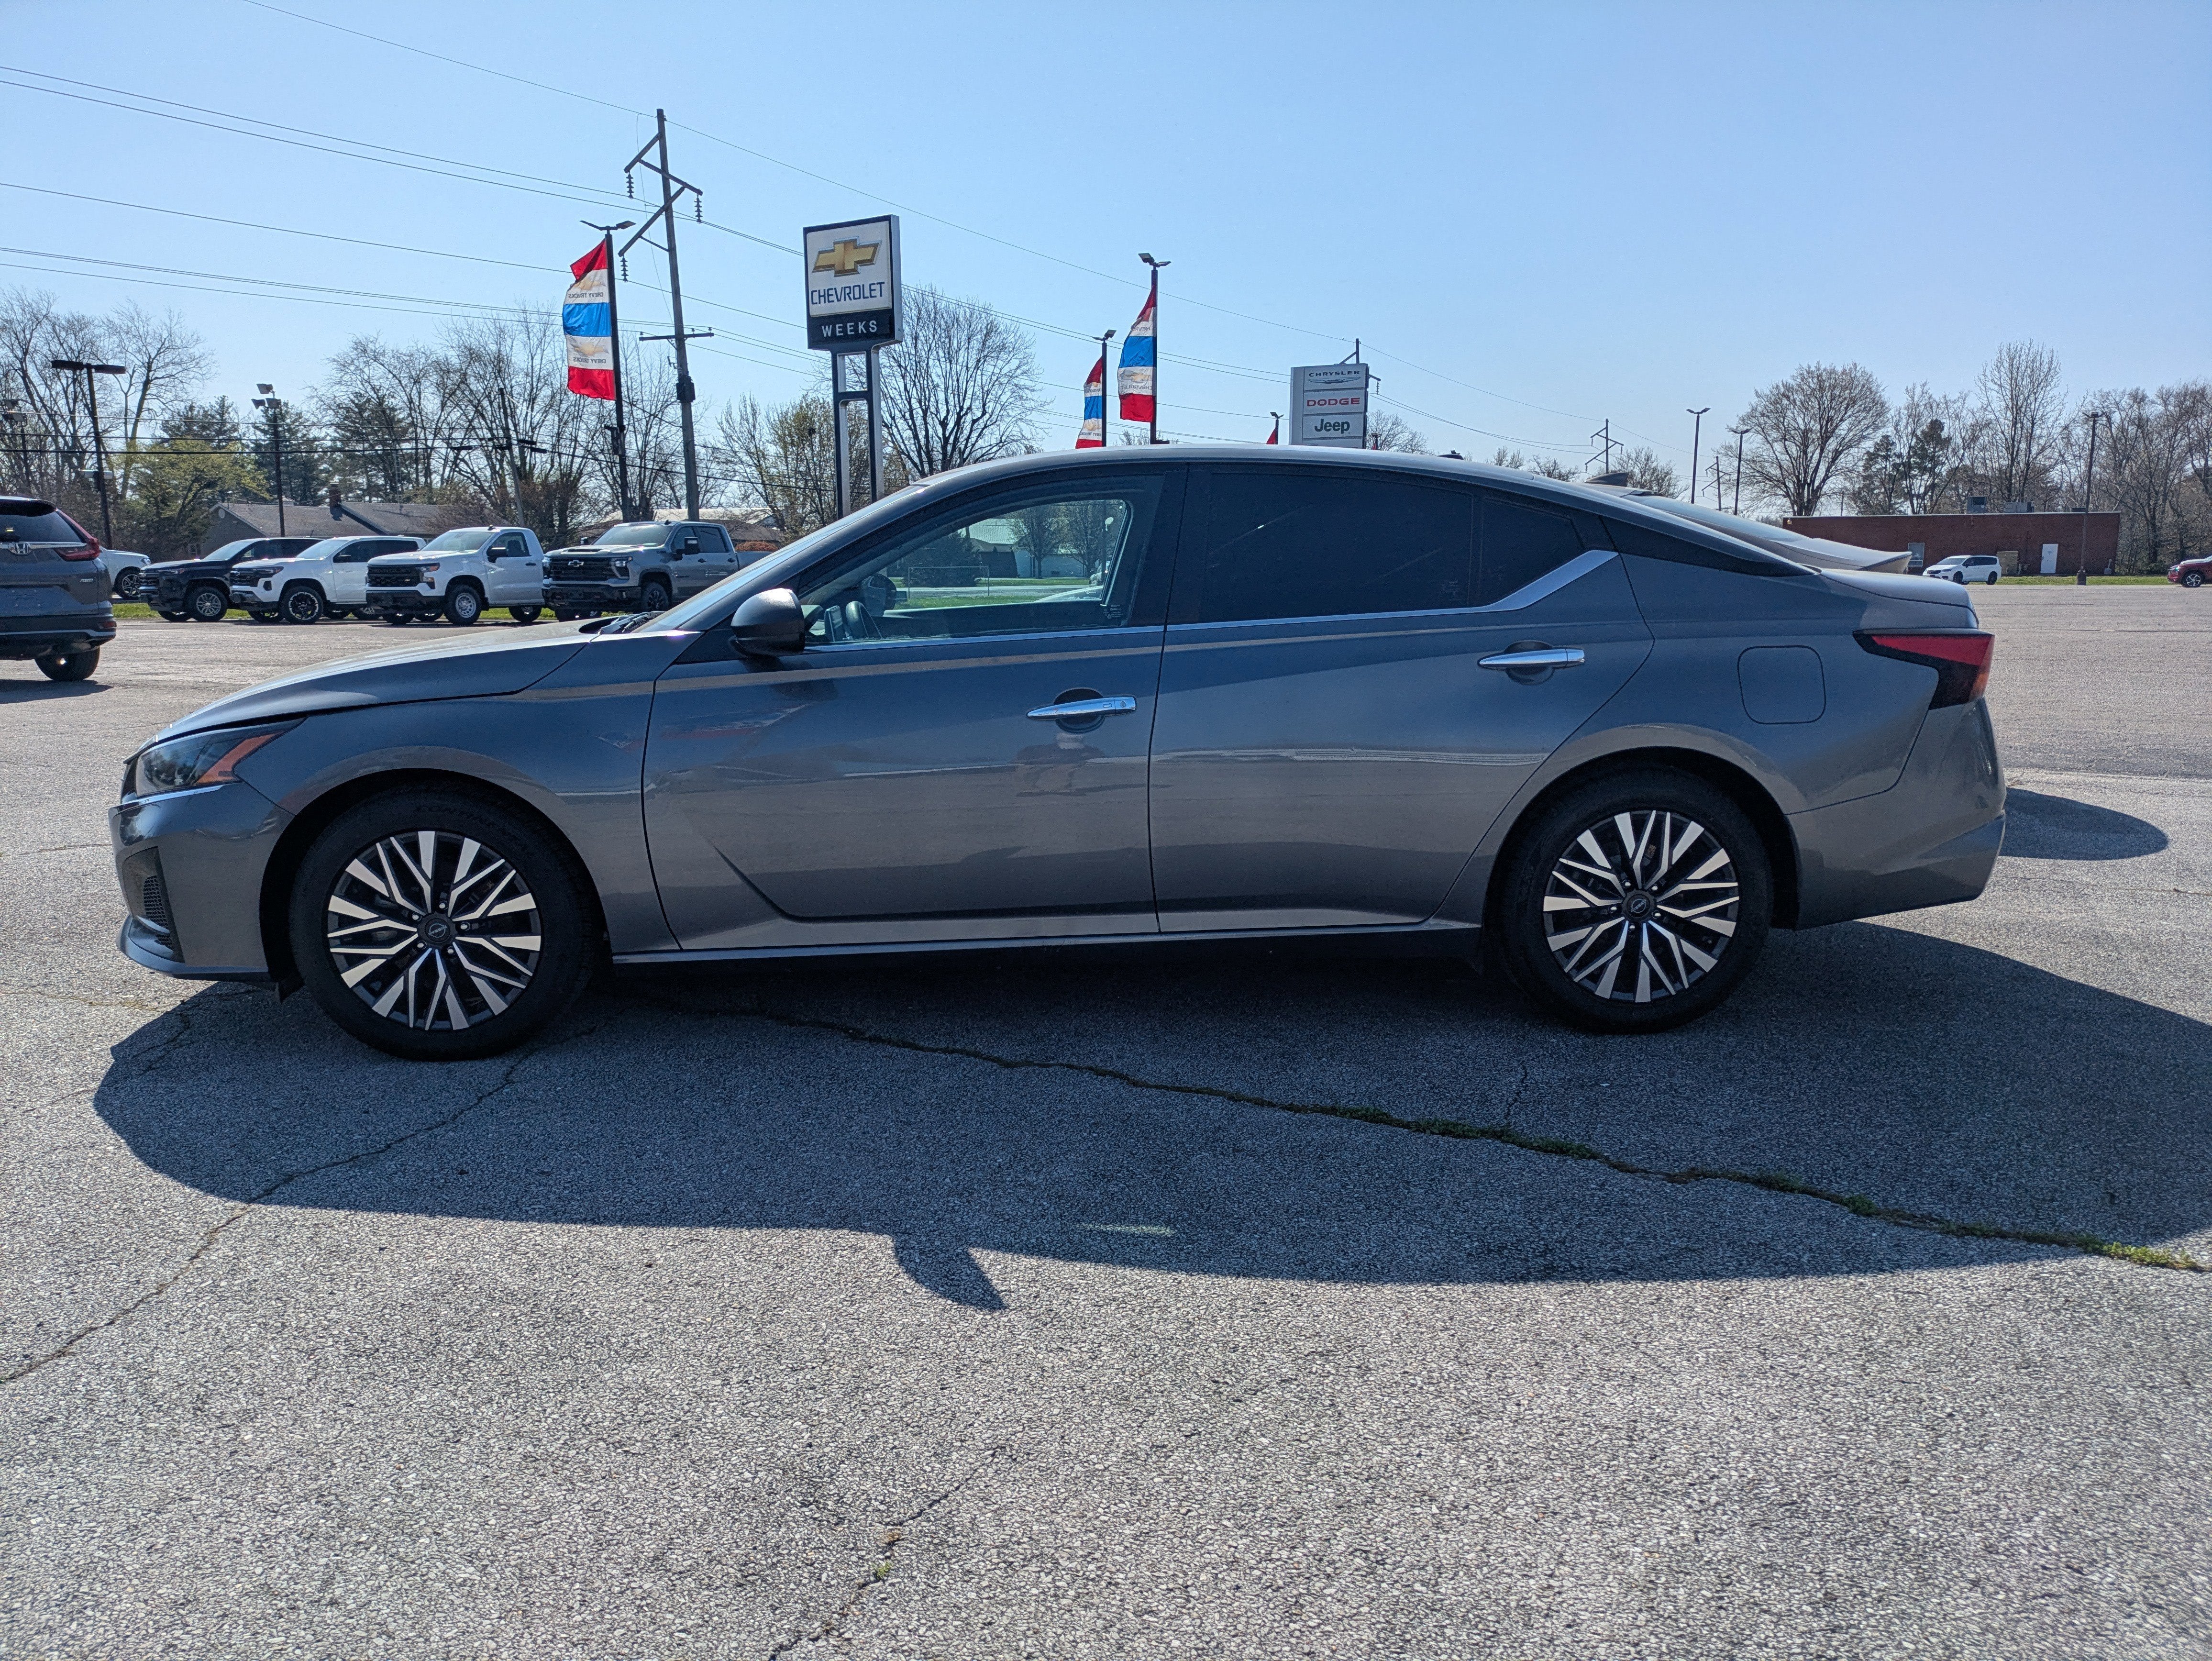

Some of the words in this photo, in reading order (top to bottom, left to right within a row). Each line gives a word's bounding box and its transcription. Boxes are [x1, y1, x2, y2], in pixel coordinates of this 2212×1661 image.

[810, 281, 885, 305] CHEVROLET
[821, 320, 877, 337] WEEKS
[1307, 397, 1360, 407] DODGE
[1314, 419, 1350, 434] Jeep
